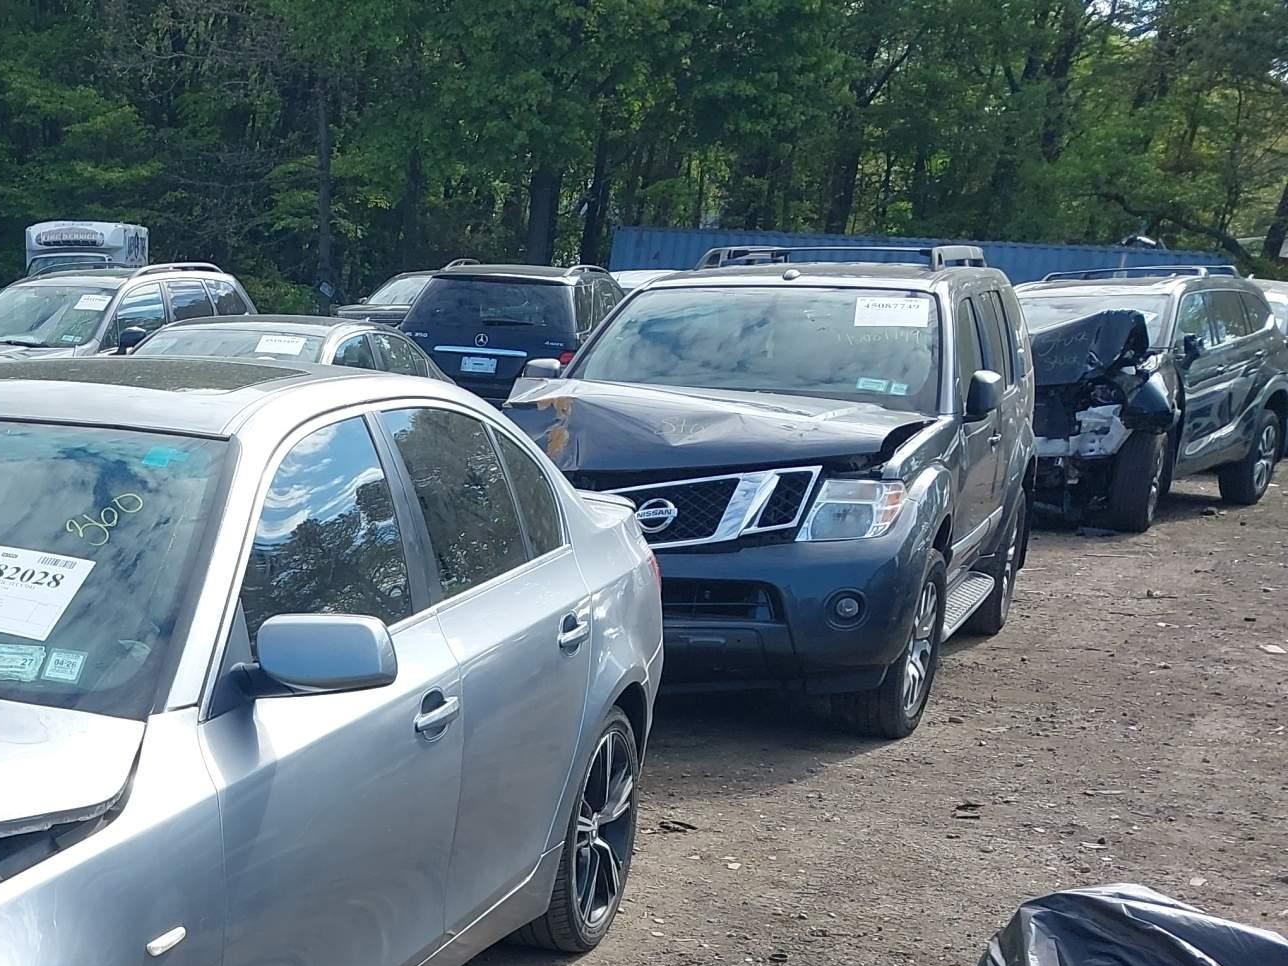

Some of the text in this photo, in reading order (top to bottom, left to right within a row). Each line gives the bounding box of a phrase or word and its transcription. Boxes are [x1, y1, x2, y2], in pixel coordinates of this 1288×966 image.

[636, 508, 673, 518] NISSAN
[66, 492, 143, 546] 360
[20, 658, 34, 666] 27
